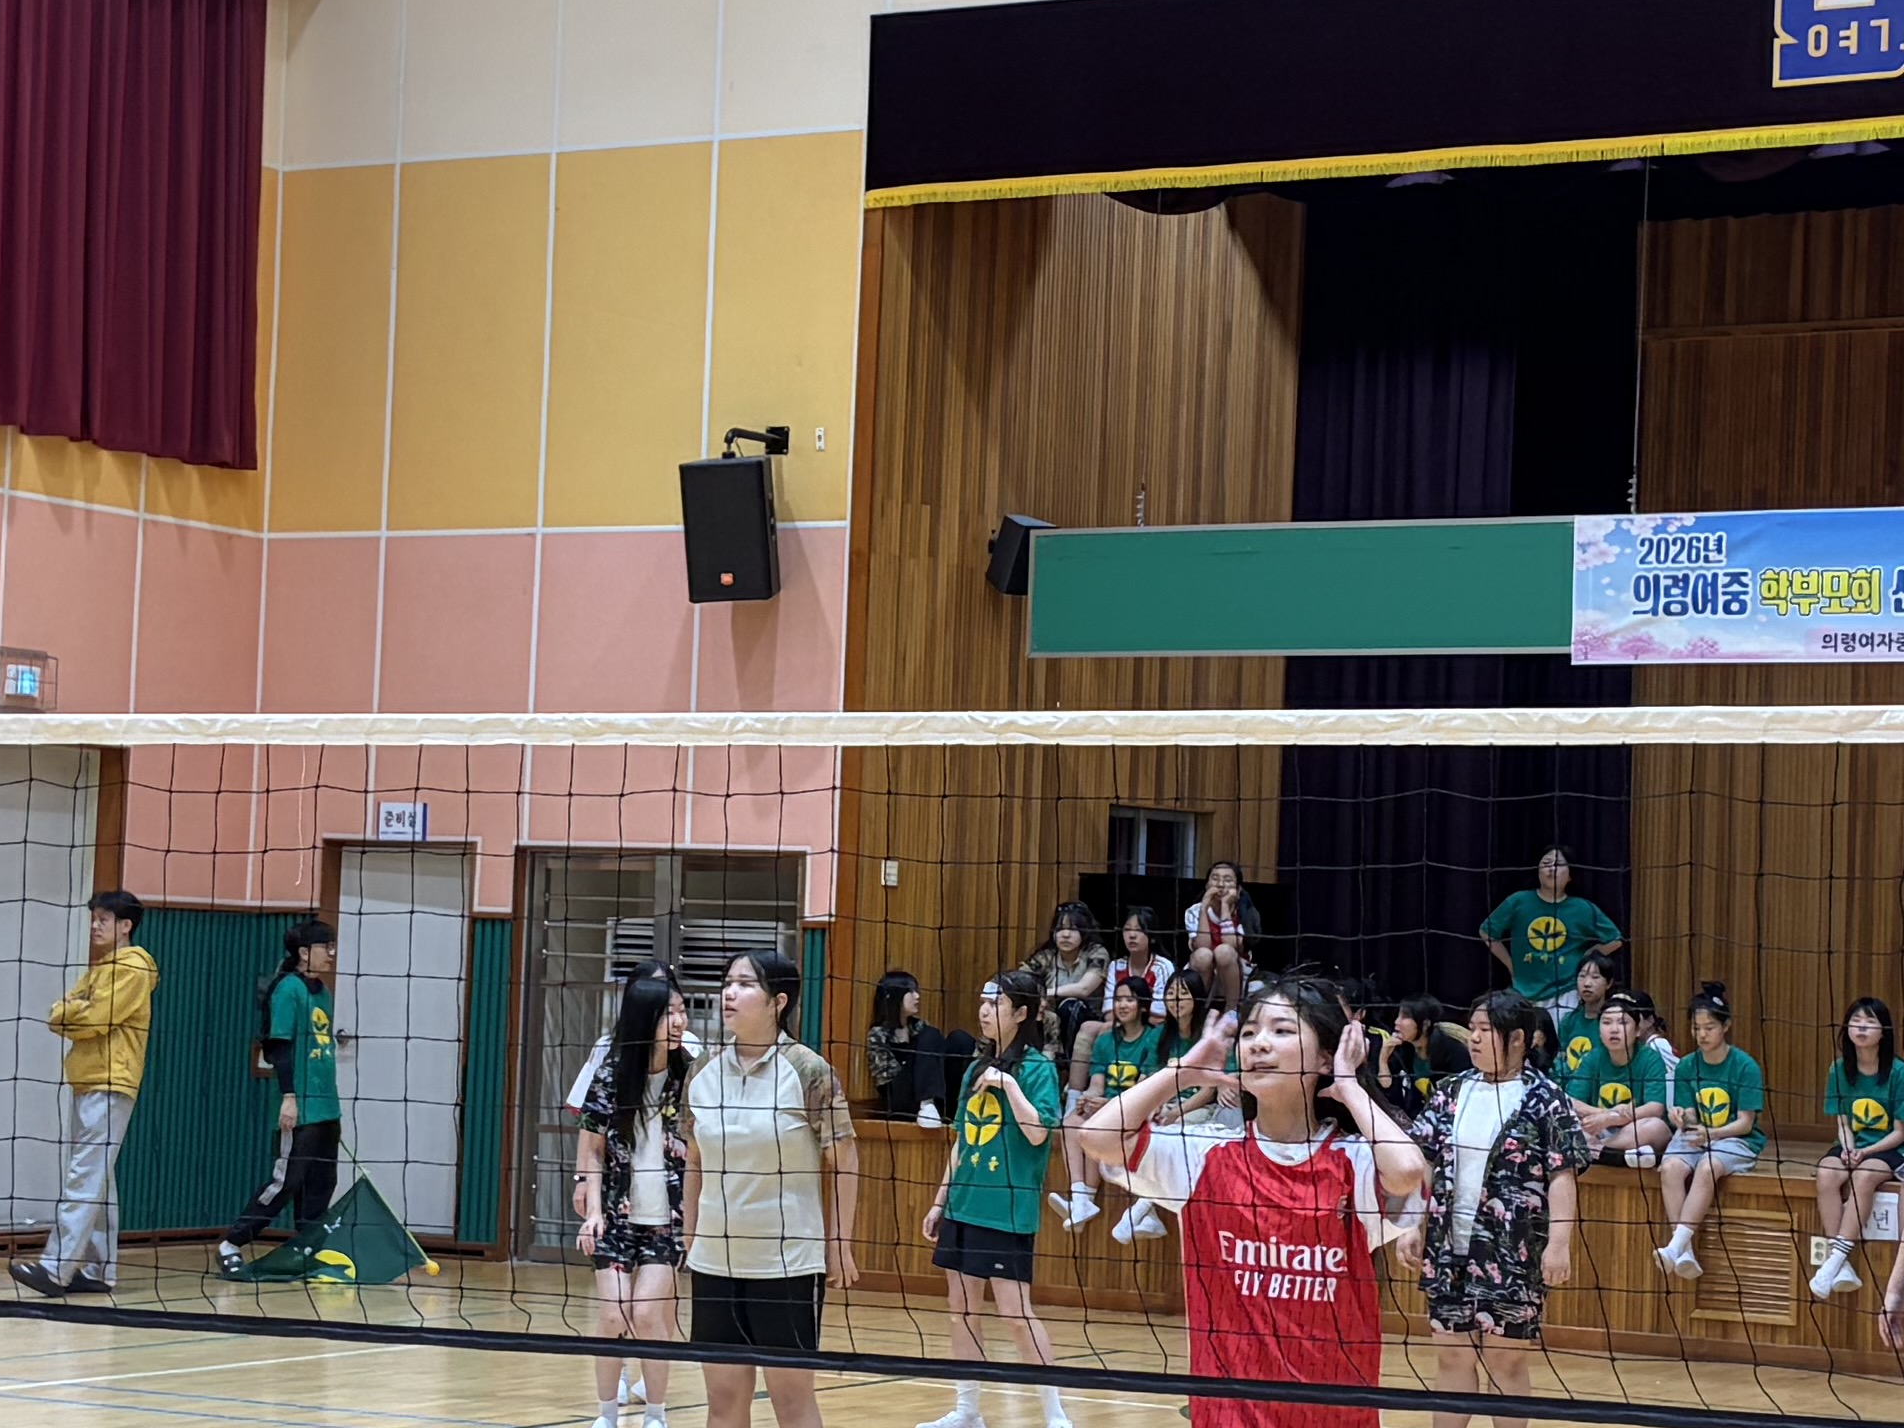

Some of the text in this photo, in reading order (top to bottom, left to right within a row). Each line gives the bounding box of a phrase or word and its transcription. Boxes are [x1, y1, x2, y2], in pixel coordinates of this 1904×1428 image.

[1638, 533, 1725, 566] 2026년
[1631, 570, 1749, 618] 의령여중
[1758, 568, 1882, 616] 학부모회
[384, 810, 417, 829] 준비실
[1218, 1230, 1348, 1273] Emirate
[1268, 1273, 1338, 1303] BETTER
